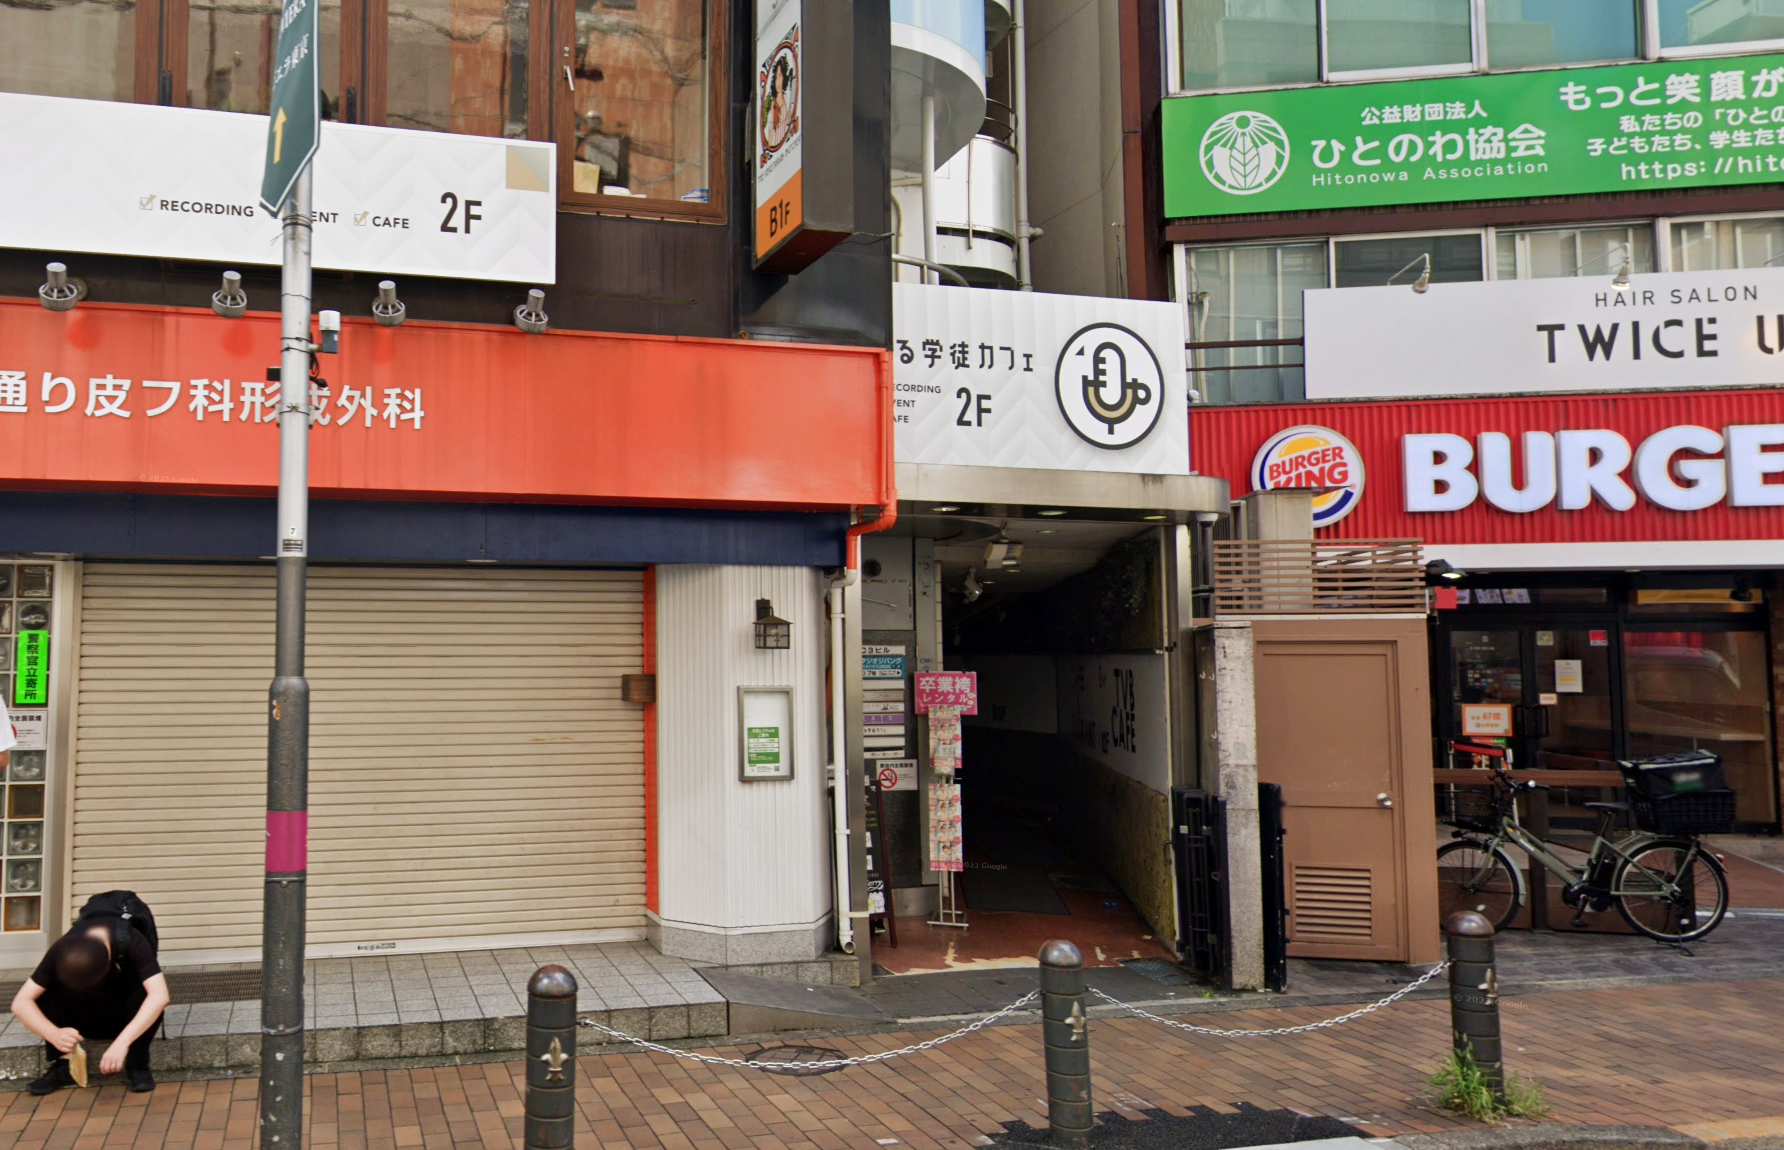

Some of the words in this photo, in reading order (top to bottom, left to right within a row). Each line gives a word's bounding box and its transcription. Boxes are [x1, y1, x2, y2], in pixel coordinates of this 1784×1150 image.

[1559, 67, 1784, 111] もっと笑顔が
[1361, 100, 1488, 126] 公益財団法人
[1311, 123, 1547, 169] ひとのわ協会
[1312, 171, 1409, 186] Hitonowa
[1423, 162, 1549, 180] Association
[160, 199, 254, 217] RECORDING
[311, 211, 338, 224] ENT
[372, 216, 410, 229] CAFE
[440, 192, 482, 234] 2F
[770, 198, 790, 238] B1F
[1595, 290, 1655, 308] HAIR
[1670, 285, 1758, 304] SALON
[896, 339, 1034, 372] る学徒カフェ
[1536, 317, 1719, 364] TWICE
[893, 383, 941, 394] CORDING
[894, 399, 916, 408] ENT
[894, 415, 909, 424] FE
[956, 387, 992, 427] 2F
[1269, 446, 1345, 482] BURGER
[1403, 424, 1784, 512] BURGE
[24, 633, 39, 700] 警察官立寄所
[919, 676, 971, 693] 卒業袴
[923, 693, 968, 703] レンタル
[1111, 705, 1136, 753] CAFE
